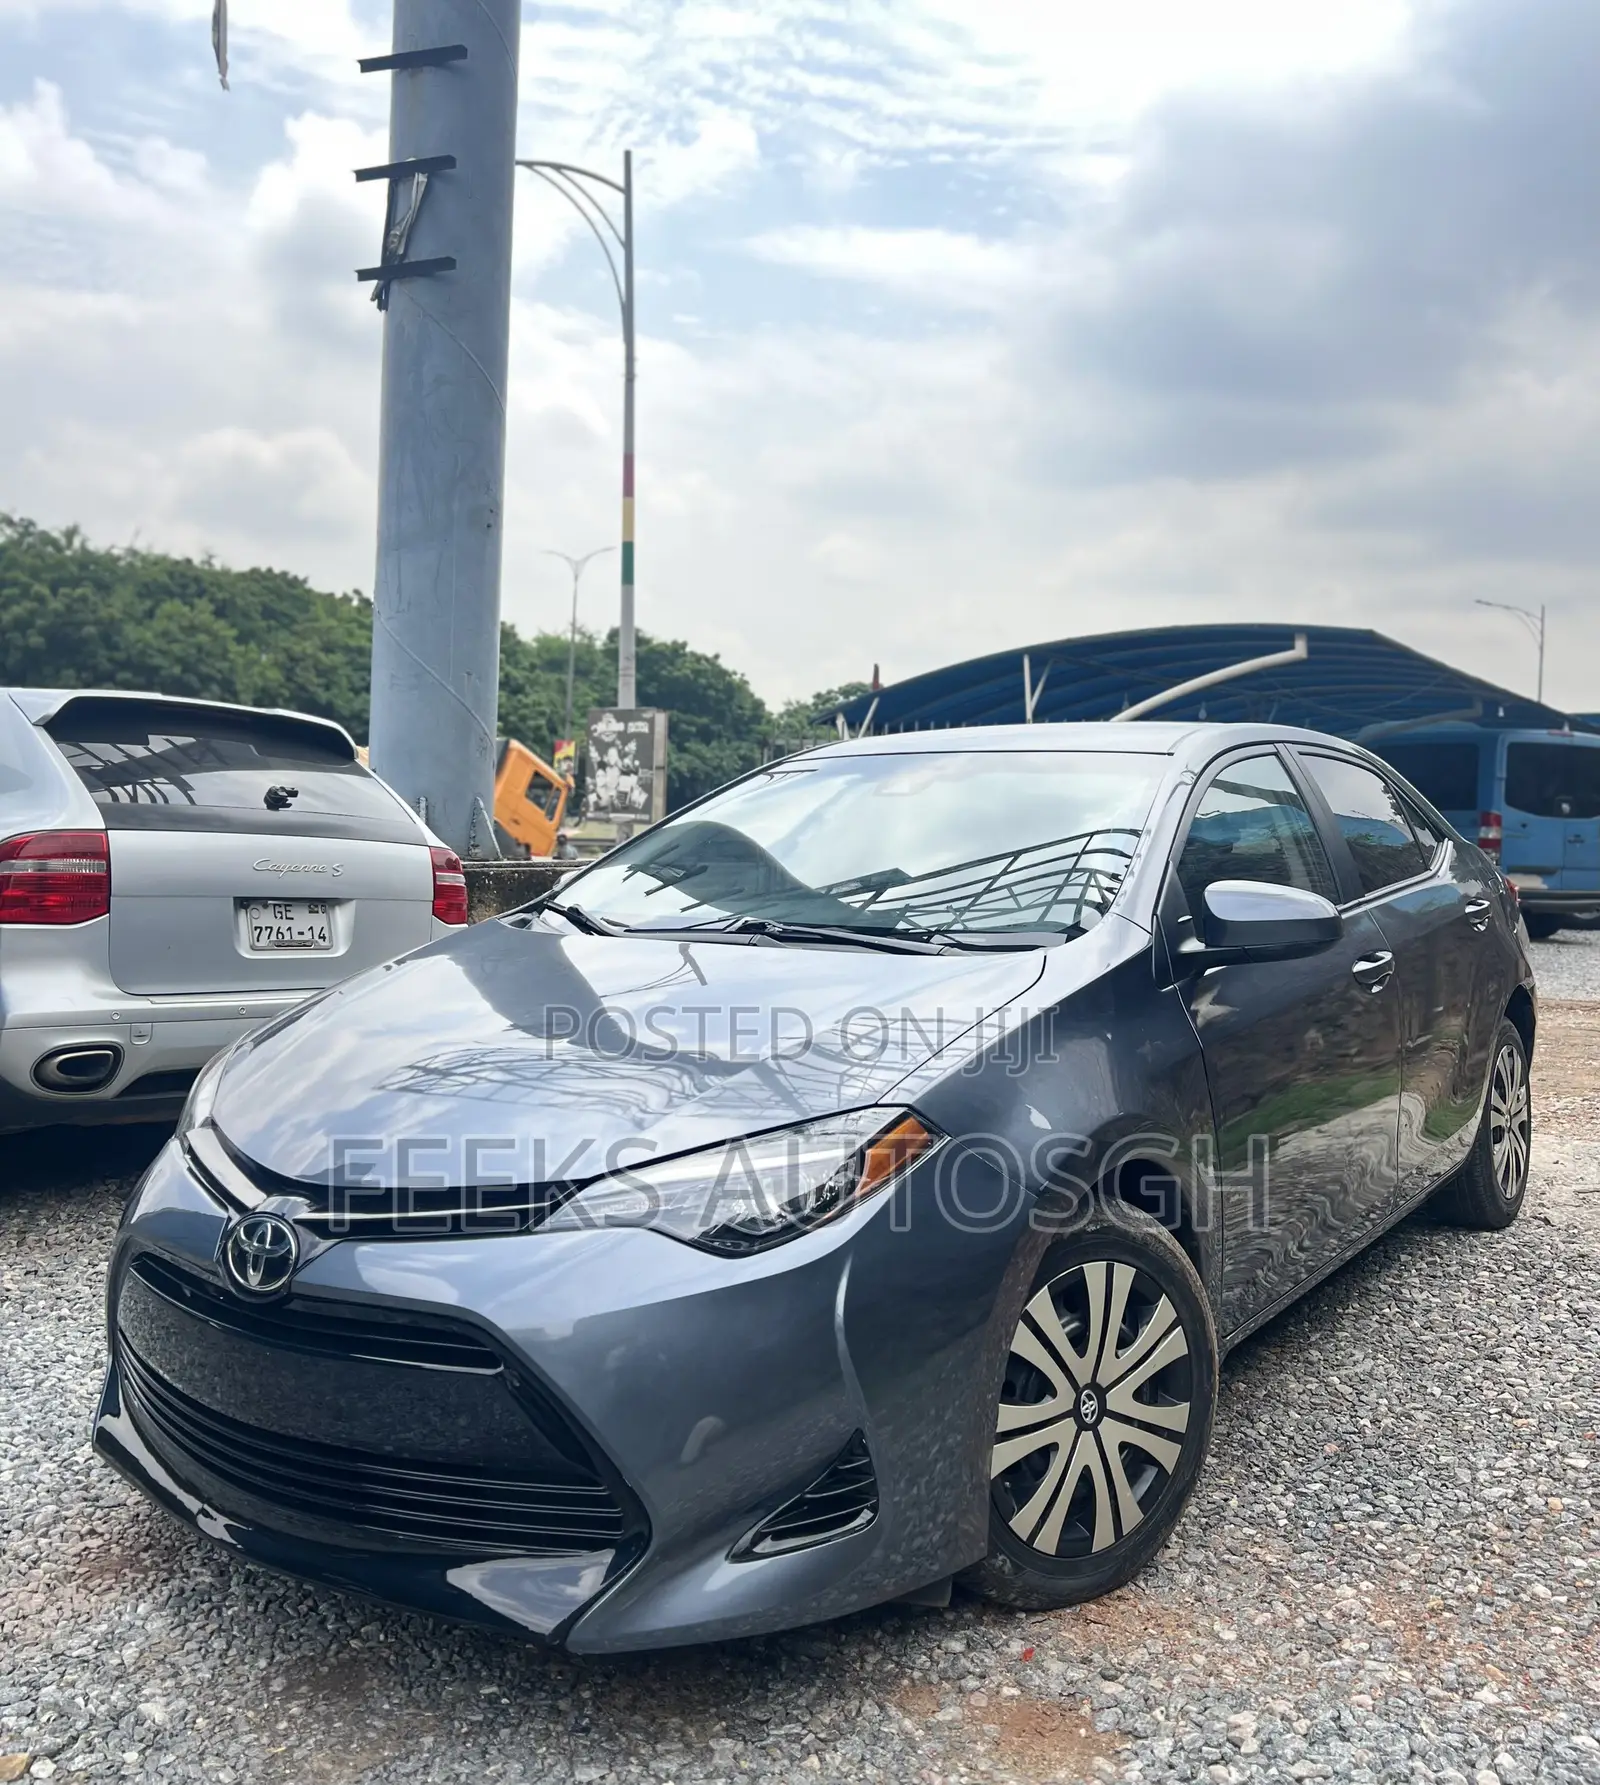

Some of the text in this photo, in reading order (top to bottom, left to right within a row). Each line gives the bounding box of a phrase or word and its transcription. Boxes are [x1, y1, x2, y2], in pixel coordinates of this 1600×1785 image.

[252, 858, 344, 879] Cayenne S
[272, 904, 294, 920] GE
[253, 925, 327, 942] 7761-14
